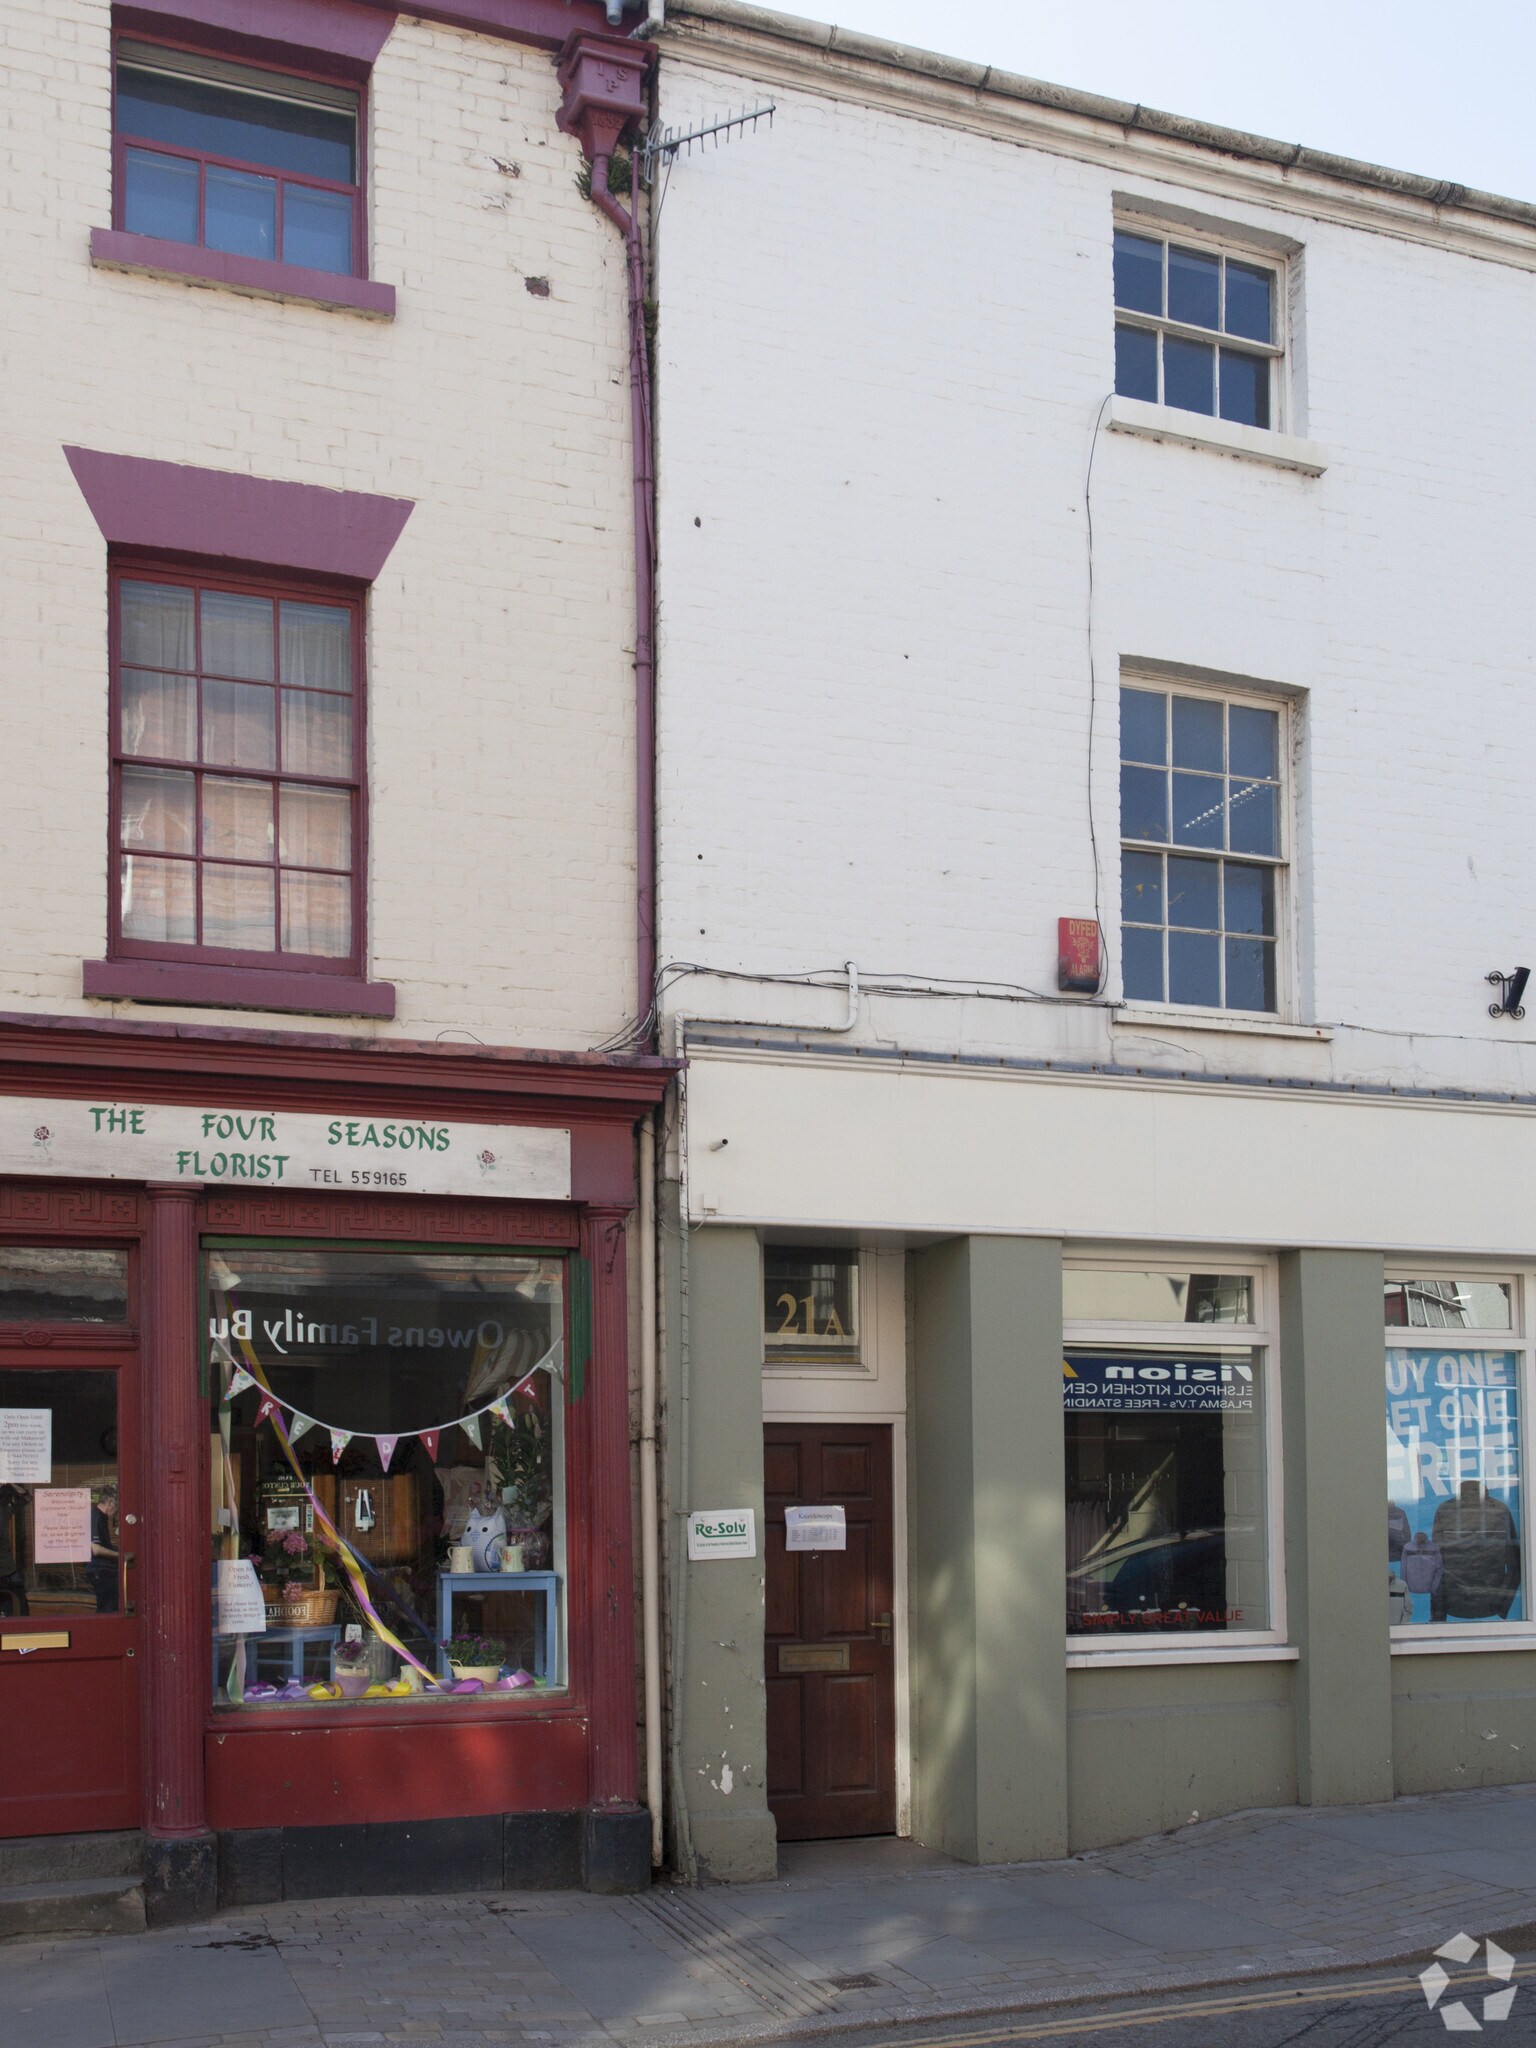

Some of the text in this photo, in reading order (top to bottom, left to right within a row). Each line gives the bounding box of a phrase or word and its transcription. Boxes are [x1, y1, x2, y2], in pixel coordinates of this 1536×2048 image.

[1069, 919, 1097, 937] DYFED
[88, 1107, 450, 1152] THE FOUR SEASONS
[176, 1150, 407, 1186] FLORIST TEL 559165
[776, 1293, 845, 1336] 21A
[1437, 1351, 1507, 1390] ONE
[1386, 1389, 1511, 1436] ET ONE
[695, 1521, 746, 1538] Re-Solv
[1083, 1610, 1244, 1626] SIMPLY GREAT VALUE
